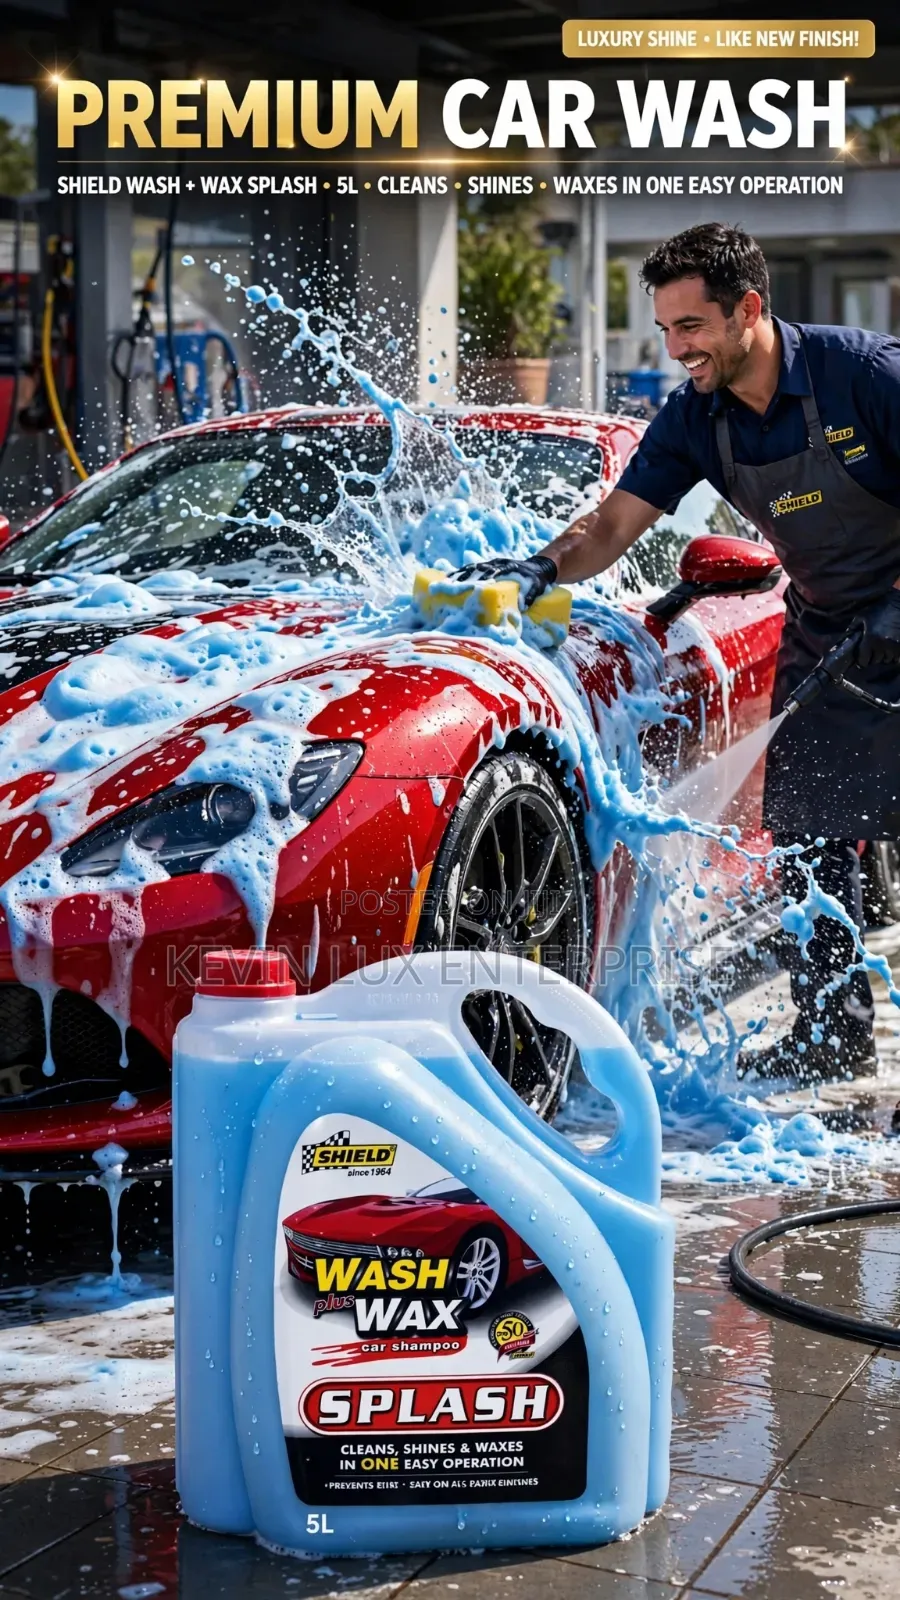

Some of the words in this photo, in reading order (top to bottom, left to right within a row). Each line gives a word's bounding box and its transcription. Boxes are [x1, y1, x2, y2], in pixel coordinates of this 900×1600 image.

[779, 494, 819, 511] SHIELD
[318, 1149, 391, 1164] SHIELD
[347, 1169, 369, 1177] since
[371, 1168, 391, 1176] 1964
[315, 1258, 449, 1292] WASH
[313, 1293, 354, 1316] plus
[355, 1298, 462, 1331] WAX
[502, 1321, 524, 1341] 50
[361, 1342, 386, 1352] car
[391, 1341, 460, 1354] shampoo
[318, 1384, 549, 1424] SPLASH
[340, 1443, 399, 1456] CLEANS,
[403, 1442, 456, 1454] SHINES
[460, 1442, 470, 1454] &
[475, 1441, 524, 1453] WAXES
[339, 1459, 356, 1470] IN
[360, 1457, 399, 1471] ONE
[404, 1458, 438, 1470] EASY
[442, 1456, 524, 1469] OPERATION
[305, 1513, 334, 1534] 5L
